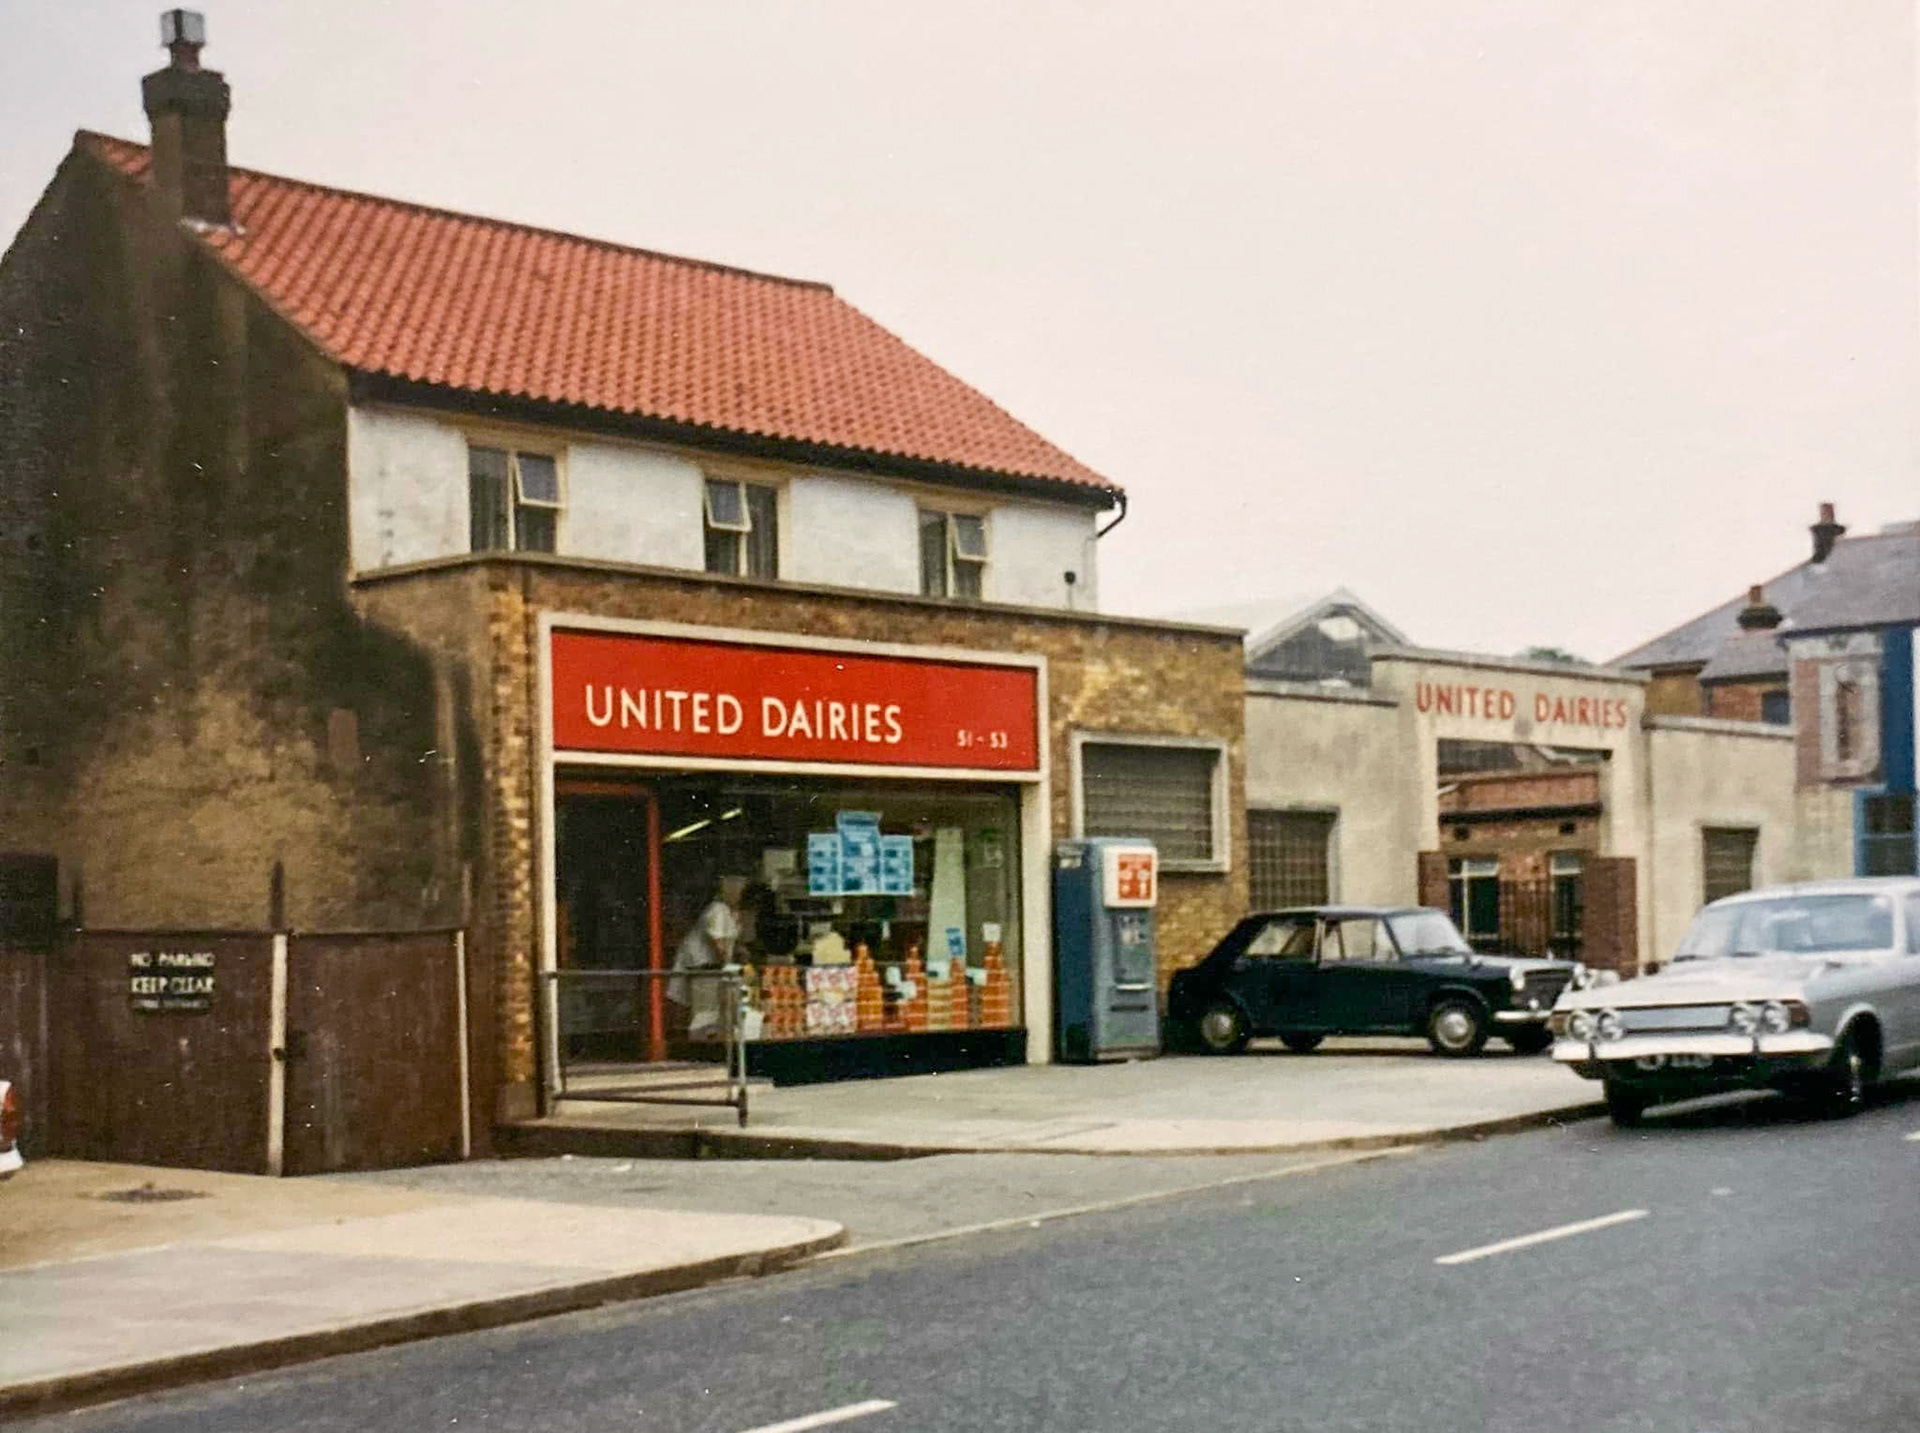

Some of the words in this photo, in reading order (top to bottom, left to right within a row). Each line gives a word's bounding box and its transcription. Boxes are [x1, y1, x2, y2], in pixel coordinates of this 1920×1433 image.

[585, 684, 743, 735] UNITED
[761, 696, 902, 744] DAIRIES
[1415, 681, 1516, 721] UNITED
[1534, 691, 1626, 728] DAIRIES
[130, 953, 151, 967] NO
[131, 976, 168, 994] KEEP
[170, 976, 214, 994] CLEAR
